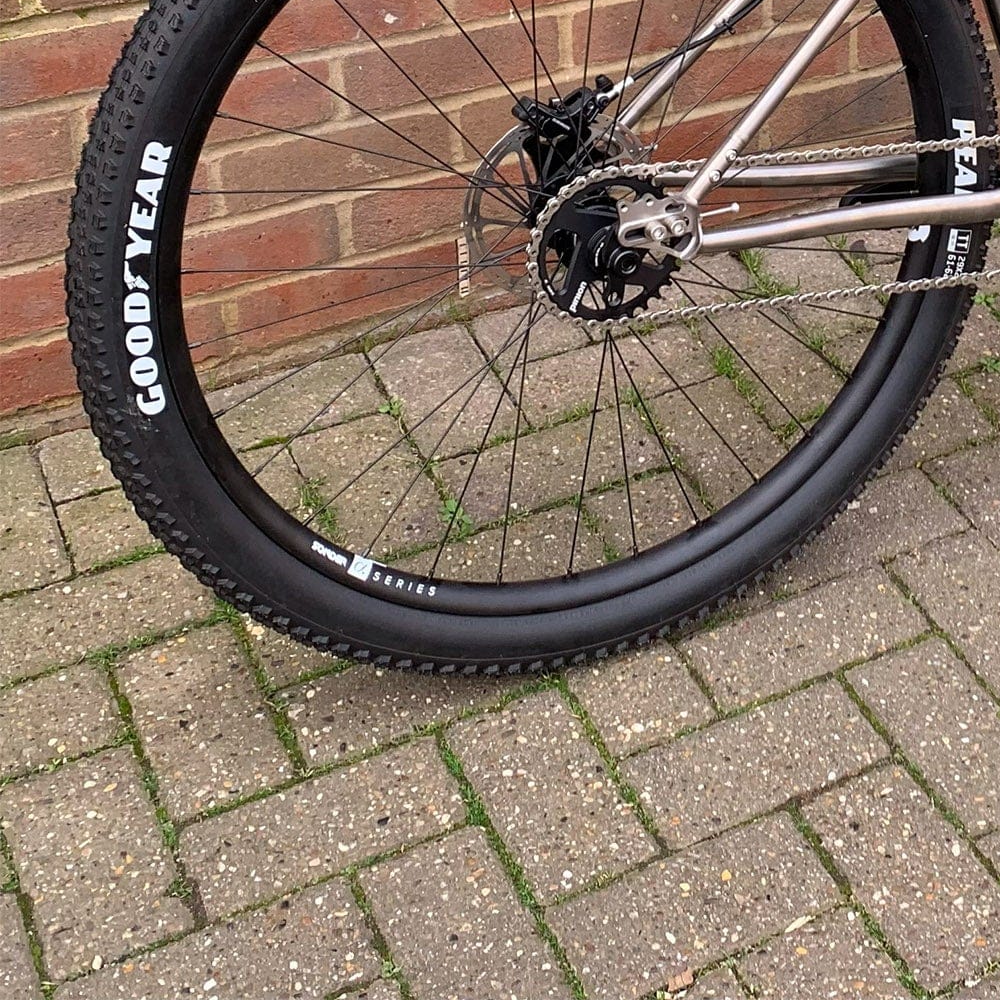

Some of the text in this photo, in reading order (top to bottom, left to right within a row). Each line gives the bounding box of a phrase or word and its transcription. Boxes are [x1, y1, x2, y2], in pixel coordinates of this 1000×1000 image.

[951, 118, 978, 195] PEA
[123, 141, 173, 416] GOODYEAR
[569, 281, 588, 313] pinion
[311, 540, 348, 568] SONDER
[372, 571, 437, 597] SERIES
